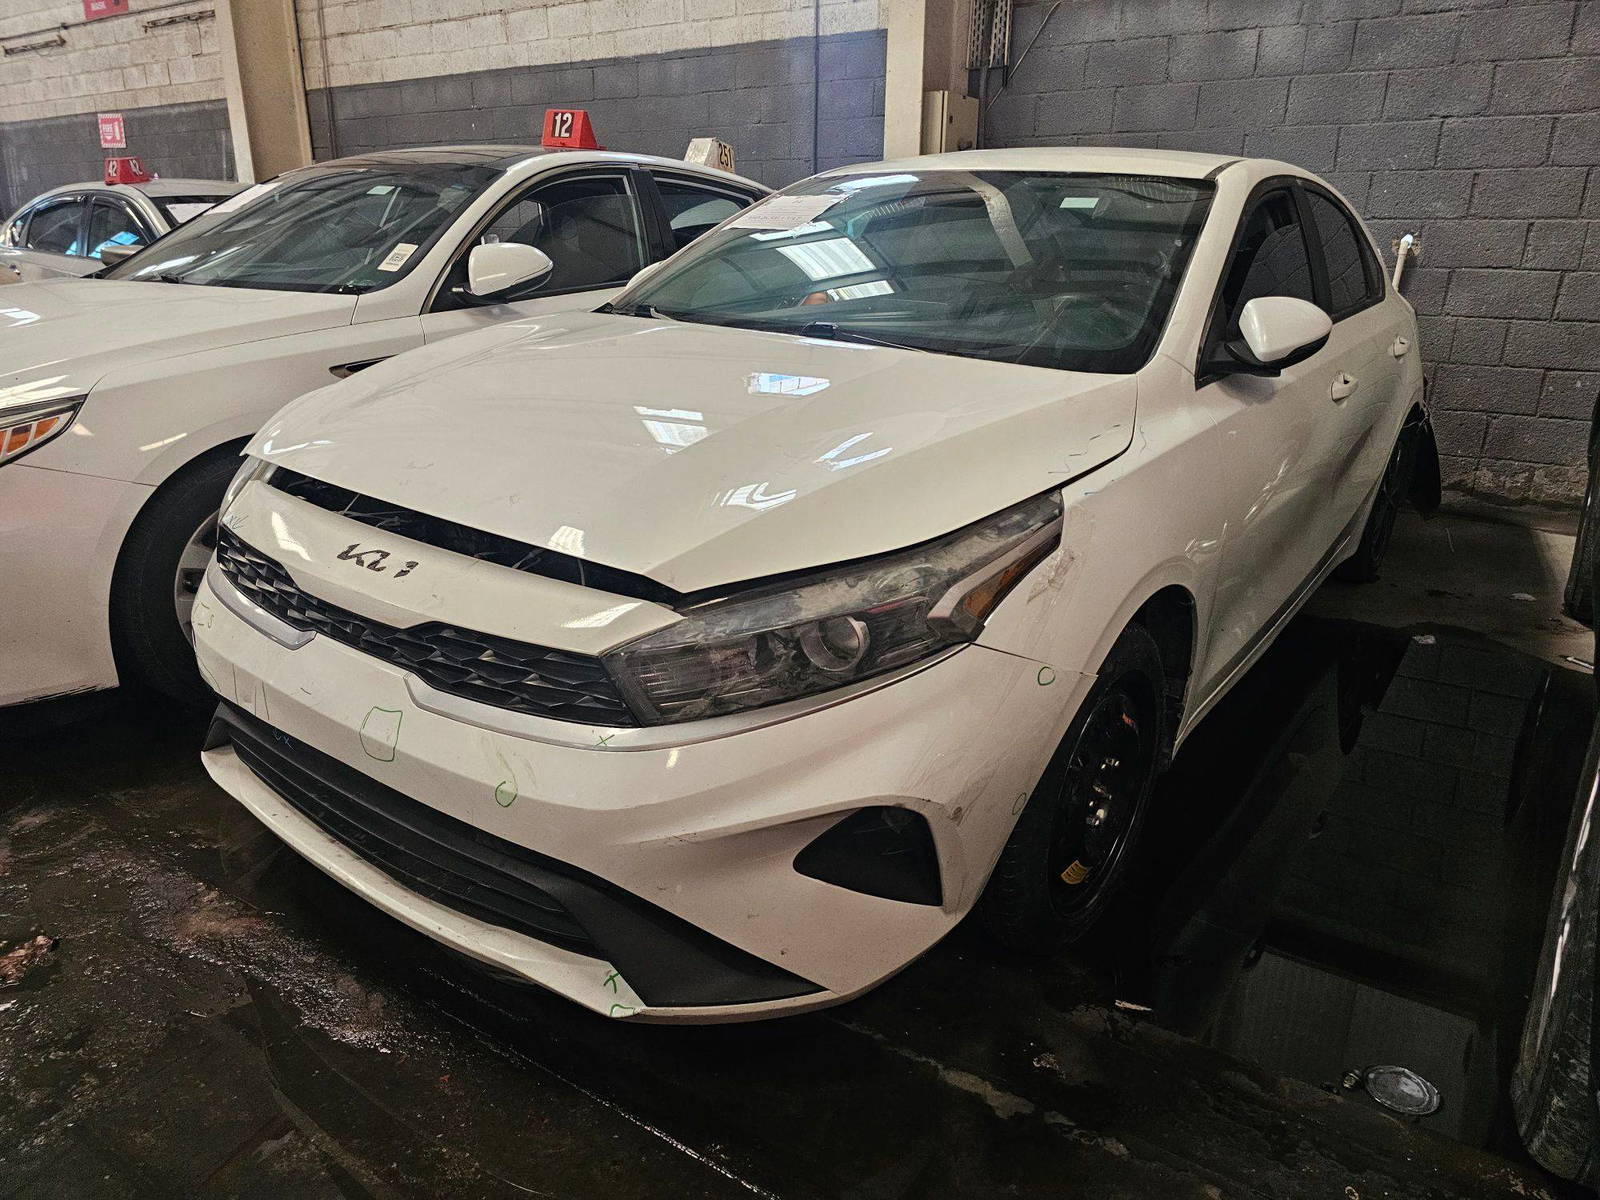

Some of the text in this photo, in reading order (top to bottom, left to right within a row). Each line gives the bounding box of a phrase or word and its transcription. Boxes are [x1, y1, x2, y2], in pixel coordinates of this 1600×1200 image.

[554, 112, 573, 138] 12
[718, 142, 733, 168] 251
[108, 160, 117, 177] 42
[128, 159, 143, 176] 42
